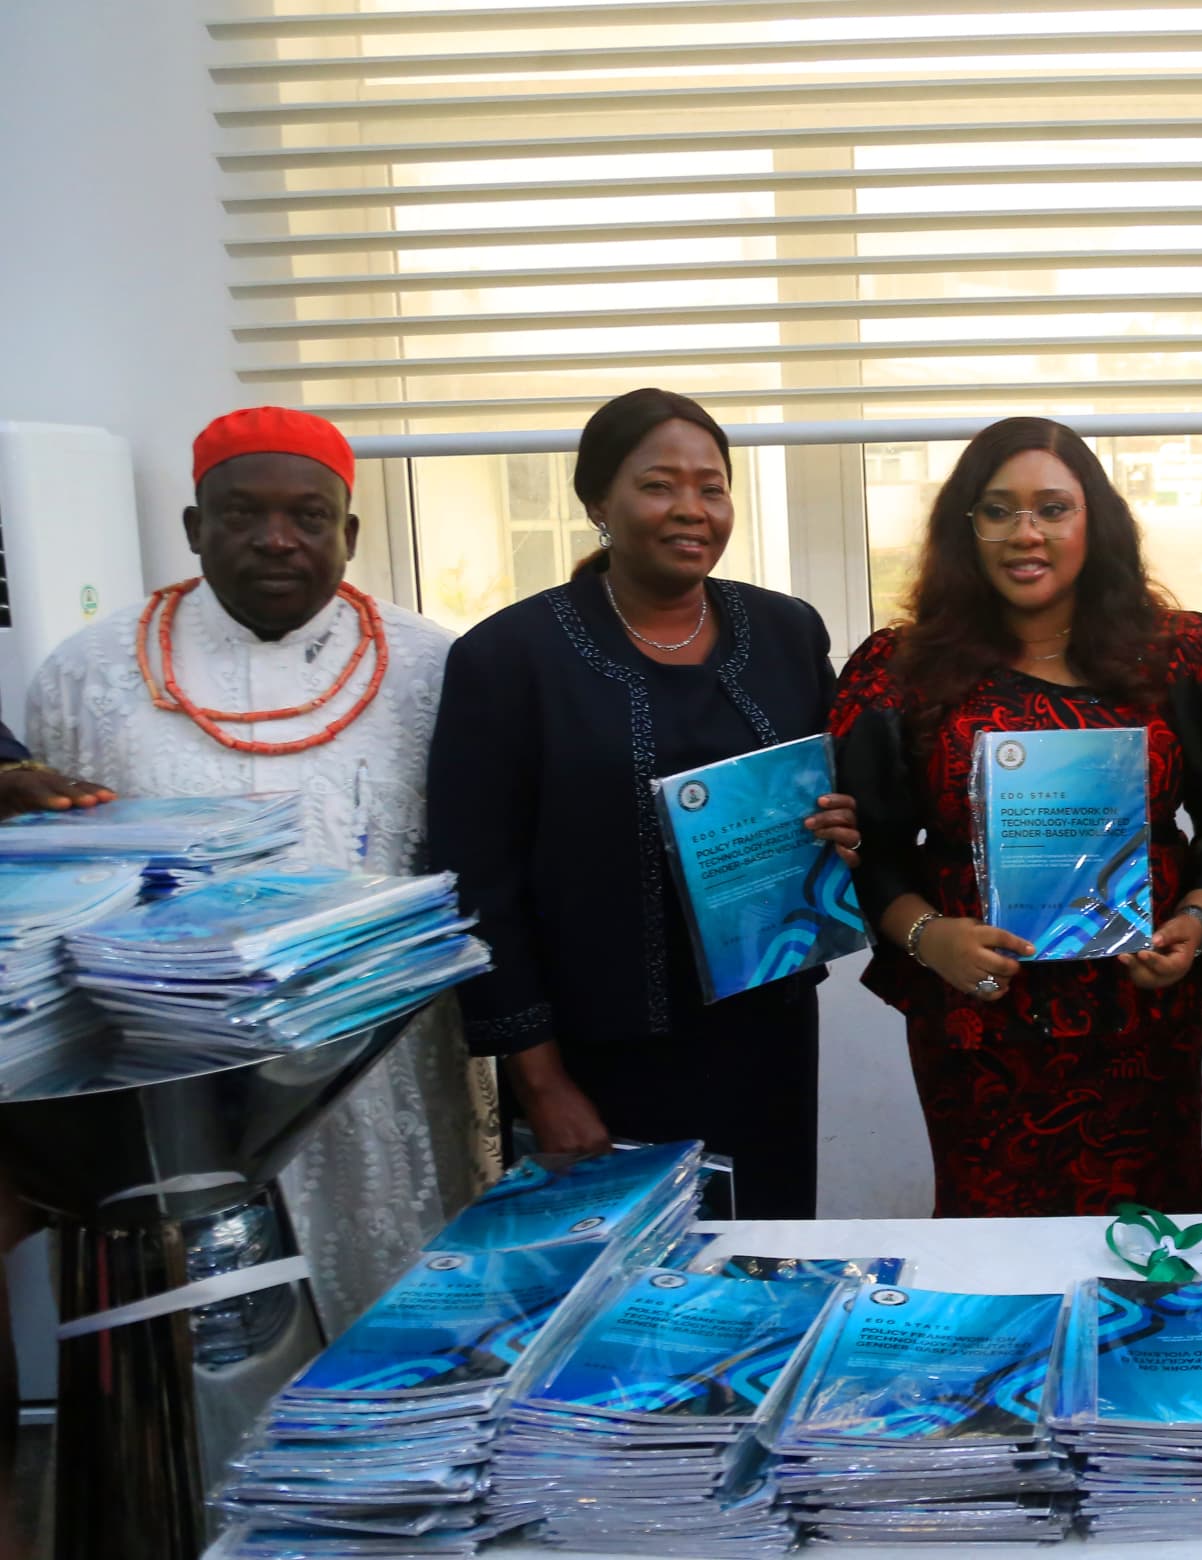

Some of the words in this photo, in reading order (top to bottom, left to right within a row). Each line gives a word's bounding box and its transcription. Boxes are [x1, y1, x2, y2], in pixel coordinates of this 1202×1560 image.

[1001, 808, 1035, 816] POLICY
[1038, 807, 1101, 815] FRAMEWORK
[1102, 807, 1117, 815] ON
[1002, 829, 1077, 837] GENDER-BASED
[696, 842, 730, 859] POLICY
[862, 1327, 907, 1336] POLICY
